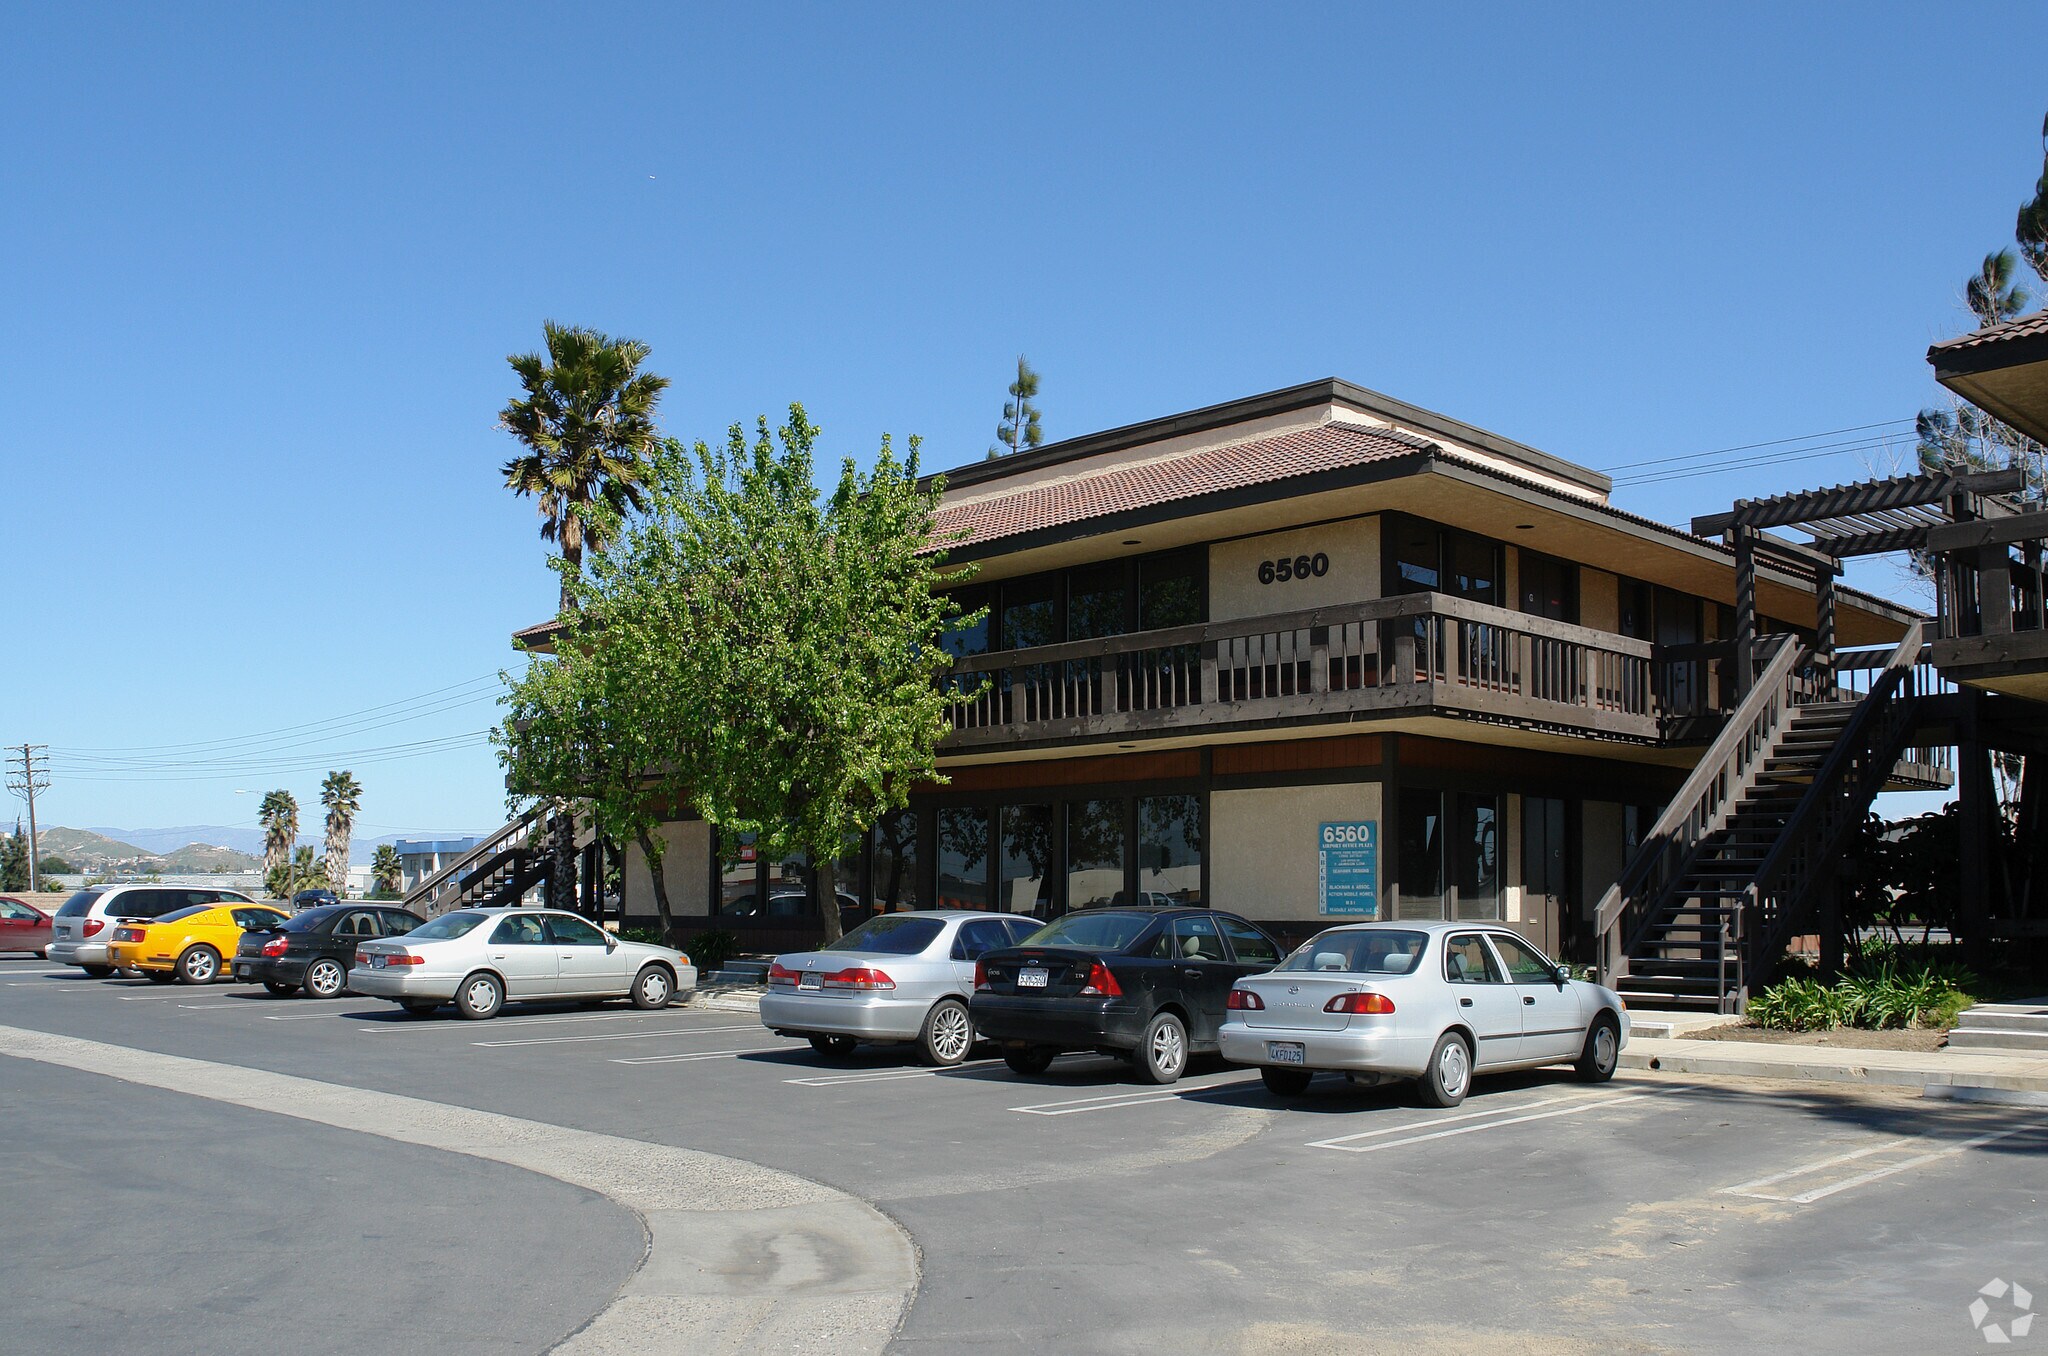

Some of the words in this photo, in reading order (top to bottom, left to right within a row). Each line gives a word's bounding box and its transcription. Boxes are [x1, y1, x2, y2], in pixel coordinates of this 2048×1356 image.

[1257, 552, 1329, 585] 6560
[1323, 825, 1369, 843] 6560
[1270, 1048, 1302, 1062] 4KFD125
